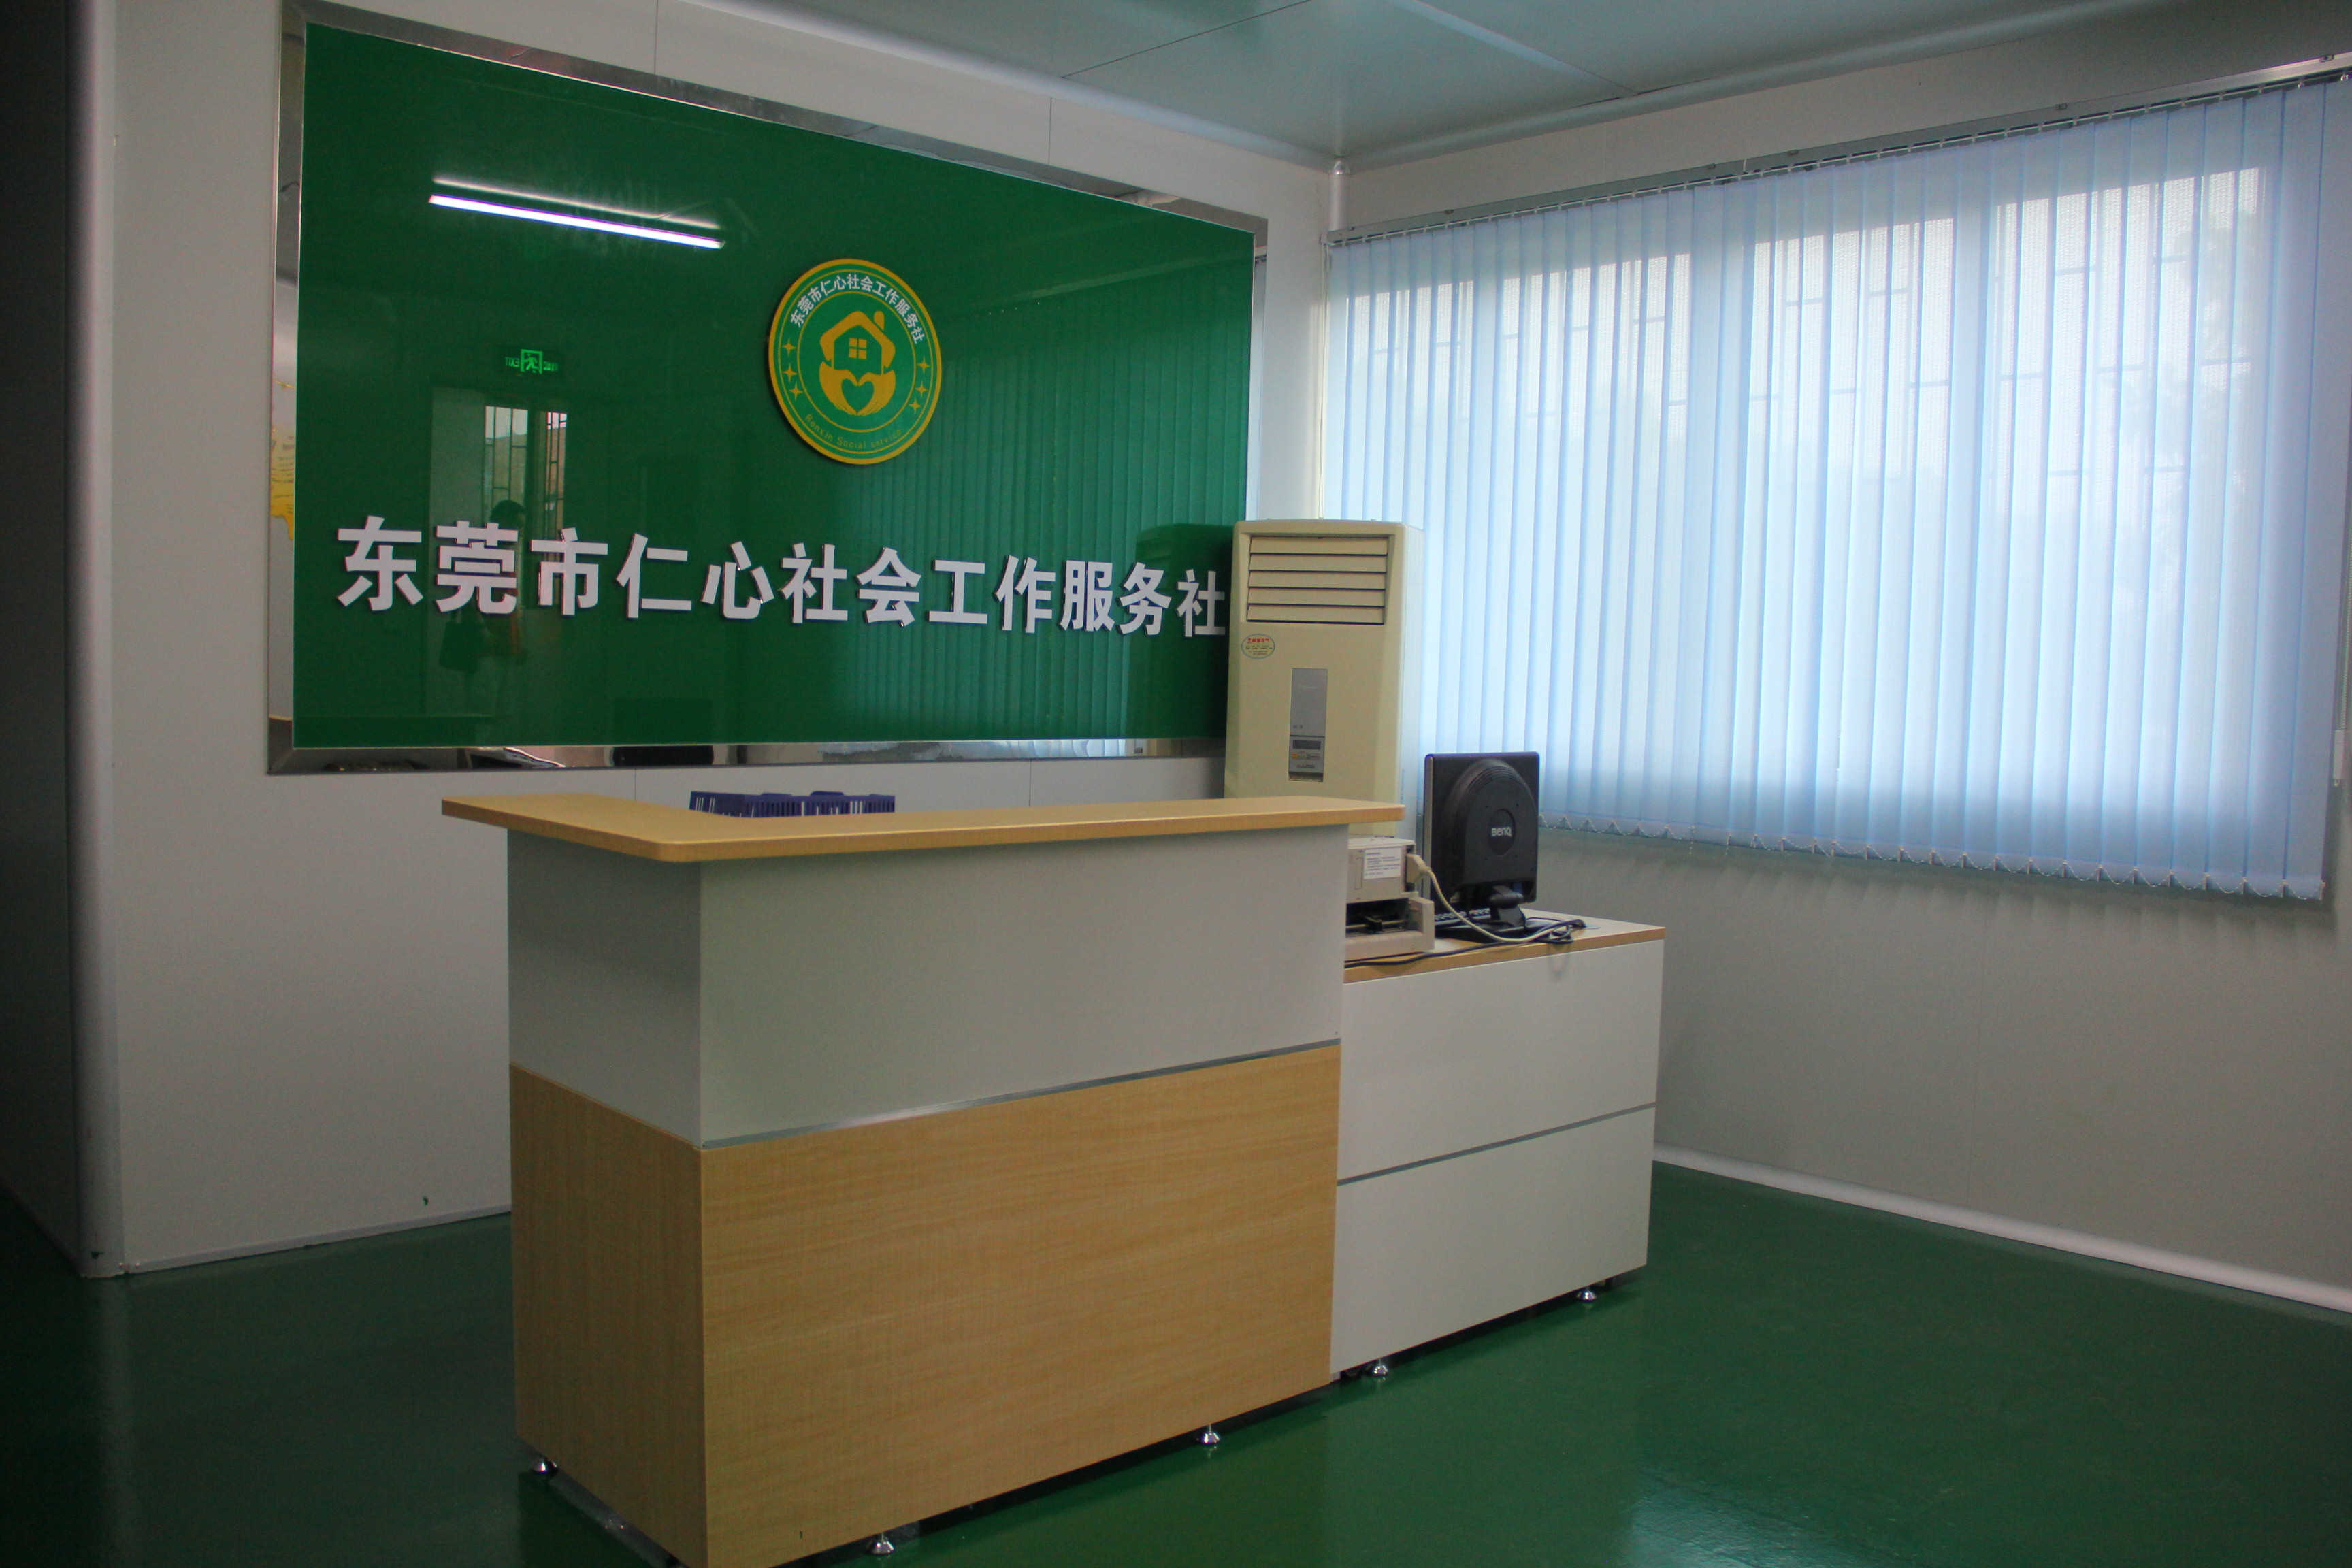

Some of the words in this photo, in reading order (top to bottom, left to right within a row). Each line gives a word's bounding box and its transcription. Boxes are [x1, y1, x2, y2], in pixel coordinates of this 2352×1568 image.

[789, 274, 924, 344] 东莞市仁心社会工作服务社
[336, 514, 1226, 638] 东莞市仁心社会工作服务社
